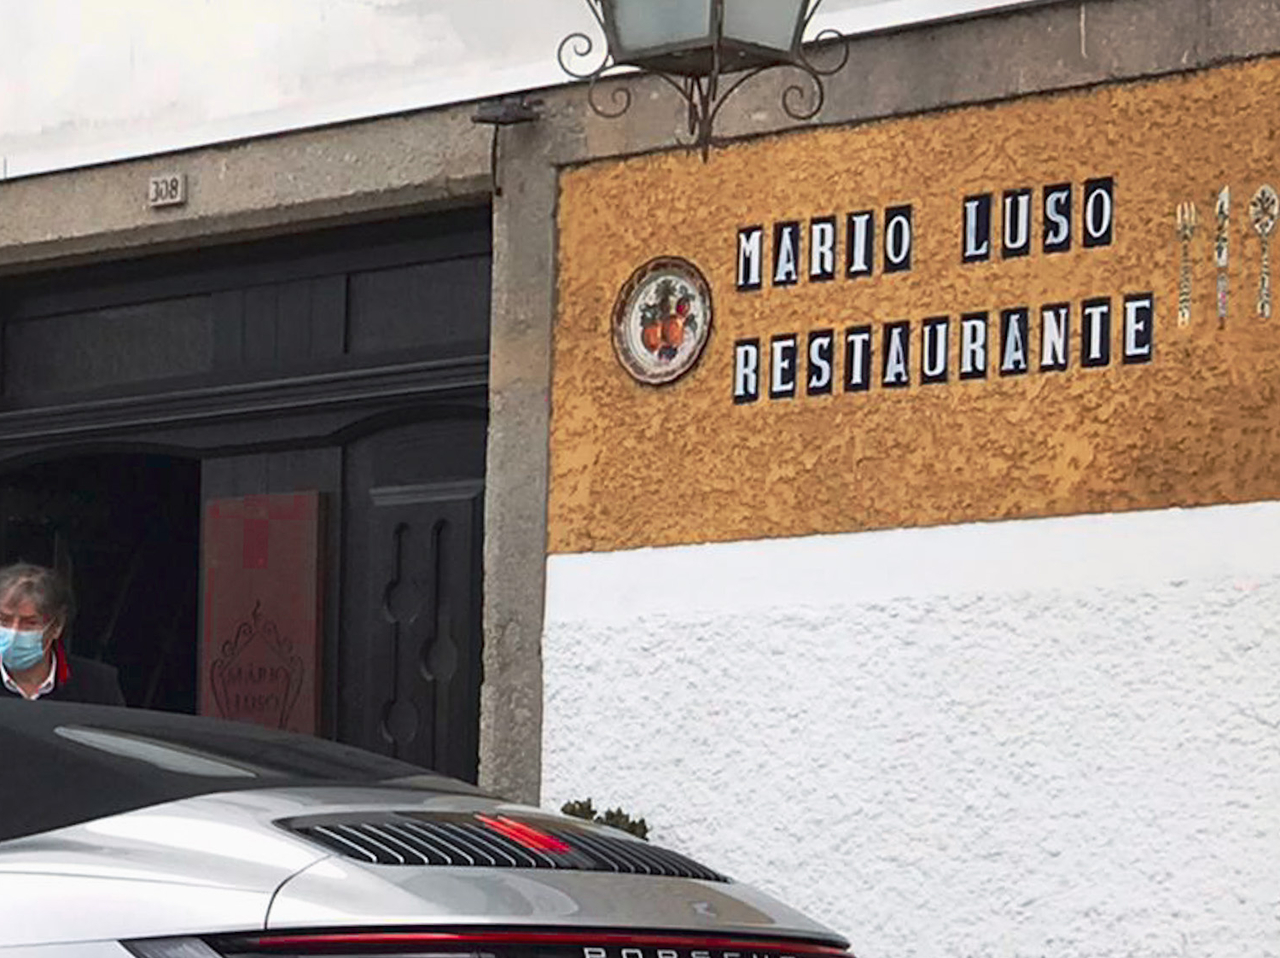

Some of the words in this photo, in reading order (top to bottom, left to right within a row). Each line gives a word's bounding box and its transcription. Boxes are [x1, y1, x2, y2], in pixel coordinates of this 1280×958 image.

[151, 177, 179, 202] 308
[737, 213, 911, 287] MARIO
[963, 186, 1112, 258] LUSO
[733, 299, 1152, 398] RESTAURANTE
